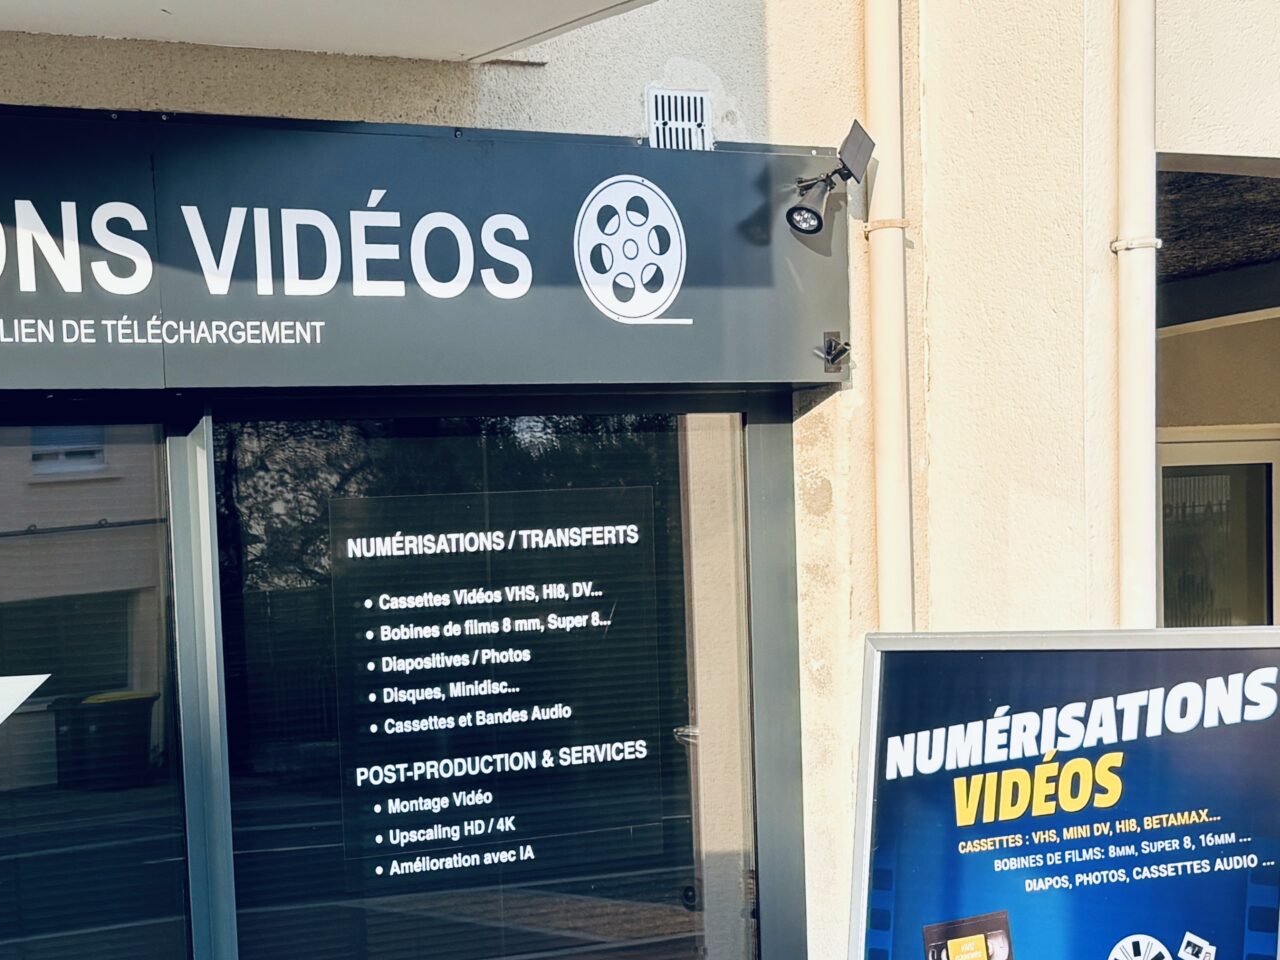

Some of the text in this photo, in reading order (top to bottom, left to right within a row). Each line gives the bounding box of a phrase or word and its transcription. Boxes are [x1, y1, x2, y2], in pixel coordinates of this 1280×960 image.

[181, 188, 533, 299] VIDÉOS
[0, 319, 55, 344] LIEN
[62, 319, 97, 344] DE
[101, 314, 326, 345] TÉLÉCHARGEMENT
[347, 524, 639, 558] NUMÉRISATIONS / TRANSFERTS
[378, 592, 451, 610] Cassettes
[453, 587, 502, 606] Vidéos
[505, 585, 540, 603] VHS,
[572, 581, 603, 598] DV...
[380, 611, 611, 642] Bobines de films 8 mm, Super 8...
[381, 647, 531, 675] Diapositives / Photos
[383, 680, 520, 705] Disques, Minidisc...
[384, 703, 572, 734] Cassettes et Bandes Audio
[885, 667, 1278, 780] NUMÉRISATIONS
[356, 740, 648, 787] POST-PRODUCTION & SERVICES
[388, 788, 493, 814] Montage Vidéo
[953, 748, 1124, 828] VIDÉOS
[389, 816, 516, 847] Upscaling HD / 4K
[958, 834, 1023, 854] CASSETTES
[1032, 829, 1061, 844] VHS,
[1063, 824, 1090, 840] MINI
[1093, 822, 1113, 837] DV,
[1115, 819, 1141, 834] HI8,
[1143, 808, 1221, 830] BETAMAX...
[389, 845, 535, 876] Amélioration avec IA
[994, 857, 1044, 872] BOBINES
[1046, 853, 1062, 866] DE
[1065, 847, 1105, 864] FILMS:
[1183, 836, 1196, 851] 8,
[1025, 874, 1073, 892] DIAPOS,
[1075, 868, 1130, 887] PHOTOS,
[1132, 859, 1210, 880] CASSETTES
[1214, 854, 1258, 872] AUDIO
